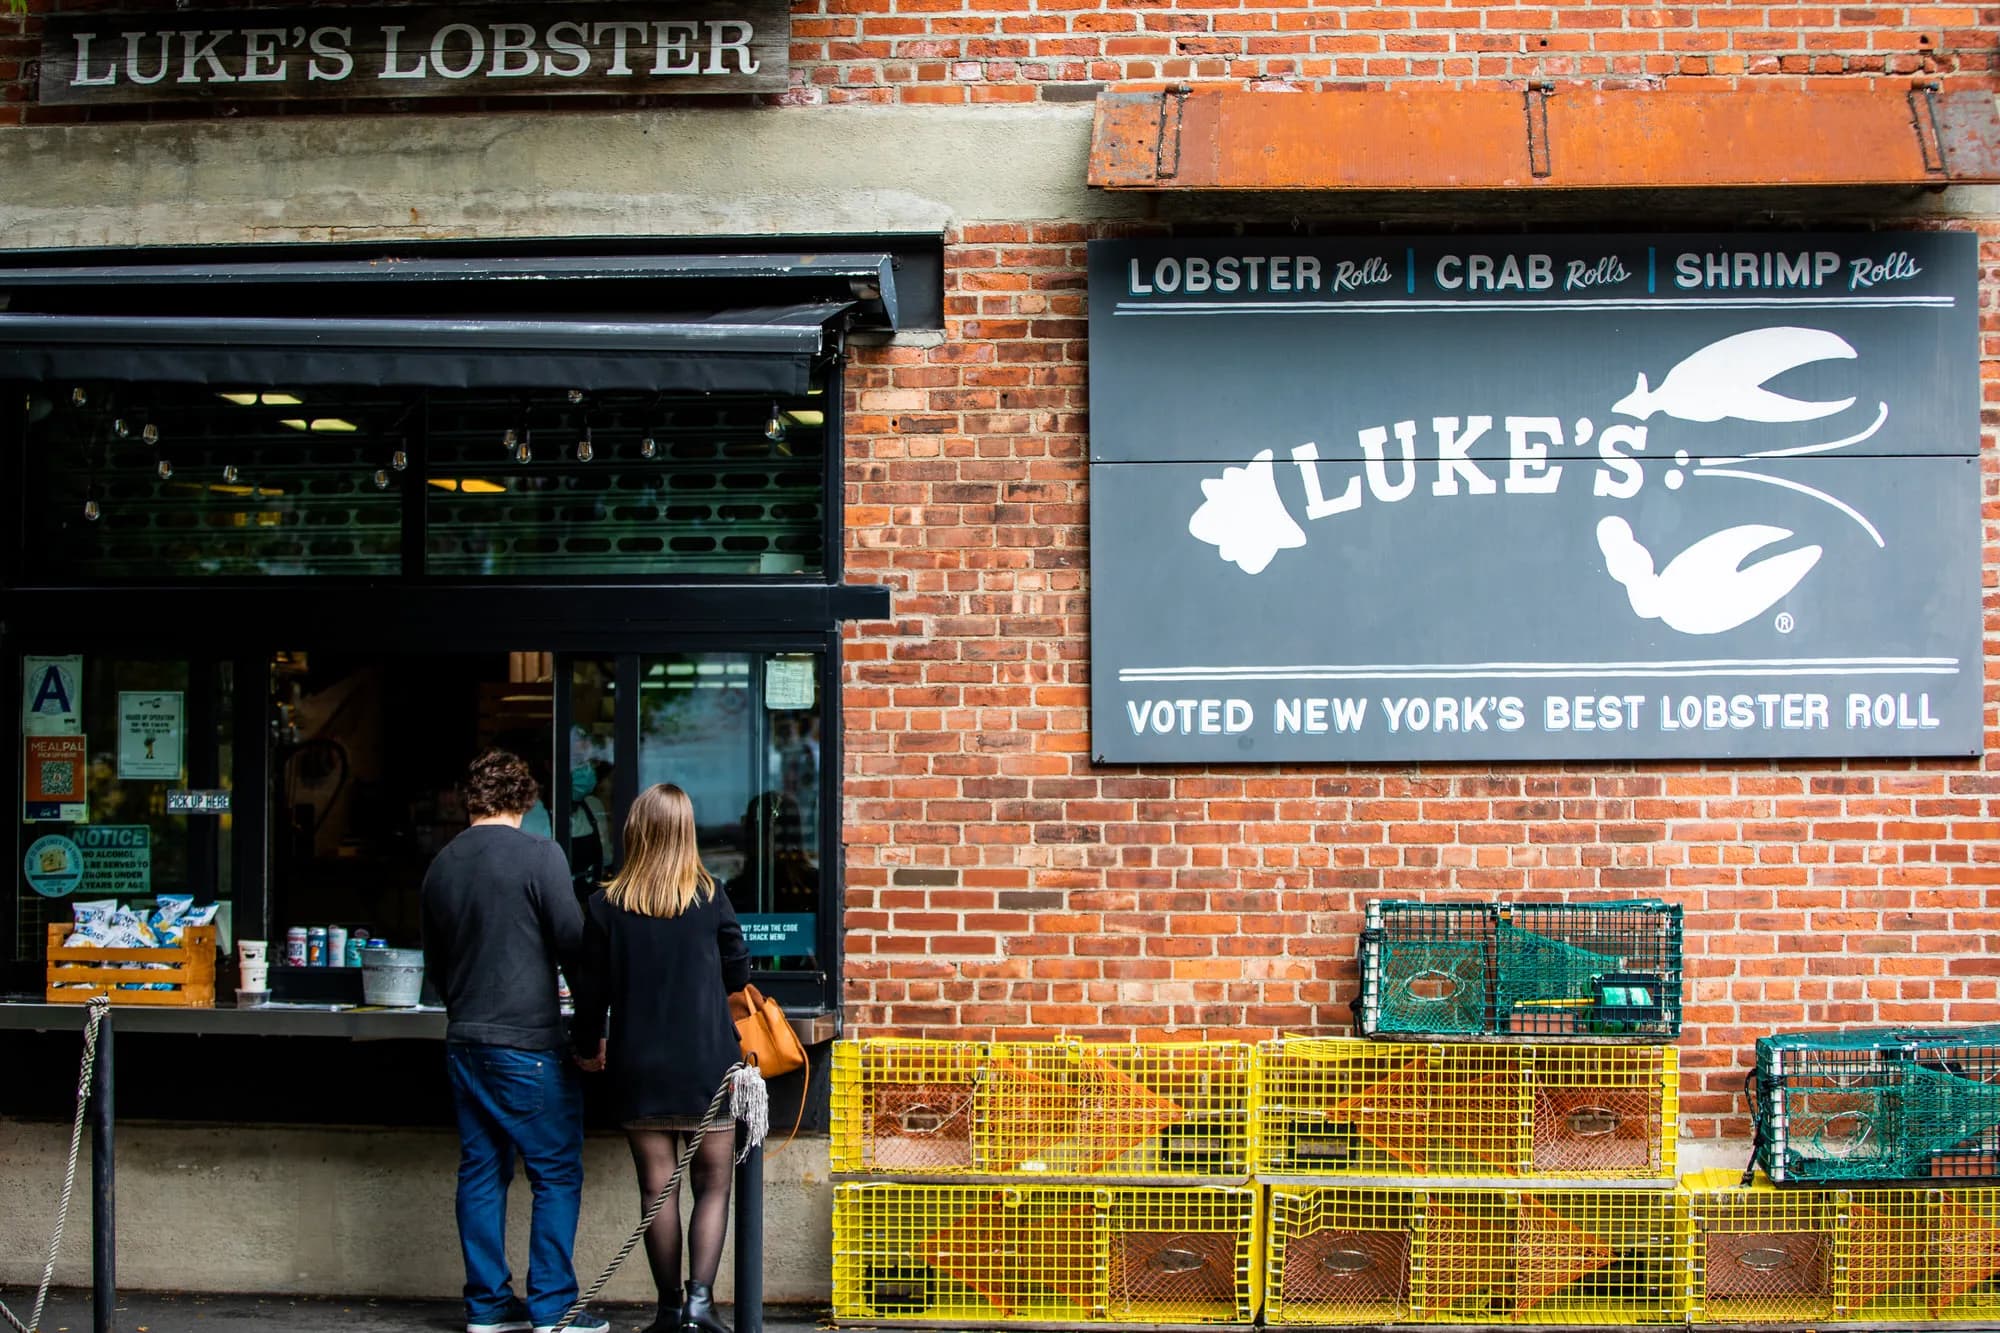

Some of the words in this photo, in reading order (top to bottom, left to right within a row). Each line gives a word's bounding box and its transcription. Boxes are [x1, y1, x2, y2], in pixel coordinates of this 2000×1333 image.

[70, 25, 354, 87] LUKE'S
[378, 20, 761, 80] LOBSTER
[1129, 256, 1321, 294] LOBSTER
[1333, 257, 1393, 292] Rolls
[1435, 253, 1554, 291] CRAB
[1565, 254, 1633, 290] Rolls
[1675, 251, 1842, 289] SHRIMP
[1849, 251, 1924, 288] Rolls
[1291, 415, 1648, 520] LUKE'S
[31, 665, 71, 713] A
[1126, 698, 1254, 735] VOTED
[1273, 697, 1368, 735] NEW
[1381, 695, 1526, 734] YORK'S
[1543, 694, 1647, 732] BEST
[1660, 692, 1830, 732] LOBSTER
[1845, 692, 1941, 731] ROLL
[31, 741, 85, 751] MEALPAL
[169, 795, 188, 809] PICK
[191, 795, 203, 809] UP
[206, 795, 229, 809] HERE
[73, 829, 145, 846] NOTICE
[96, 850, 135, 858] ALCOHOL
[104, 861, 136, 869] SERVED
[114, 871, 143, 879] UNDER
[86, 881, 113, 889] YEARS
[115, 881, 125, 889] OF
[128, 881, 145, 889] AGE
[753, 924, 769, 932] SCAN
[771, 924, 781, 932] THE
[783, 923, 798, 932] CODE
[749, 933, 769, 941] SHACK
[770, 933, 786, 941] MENU
